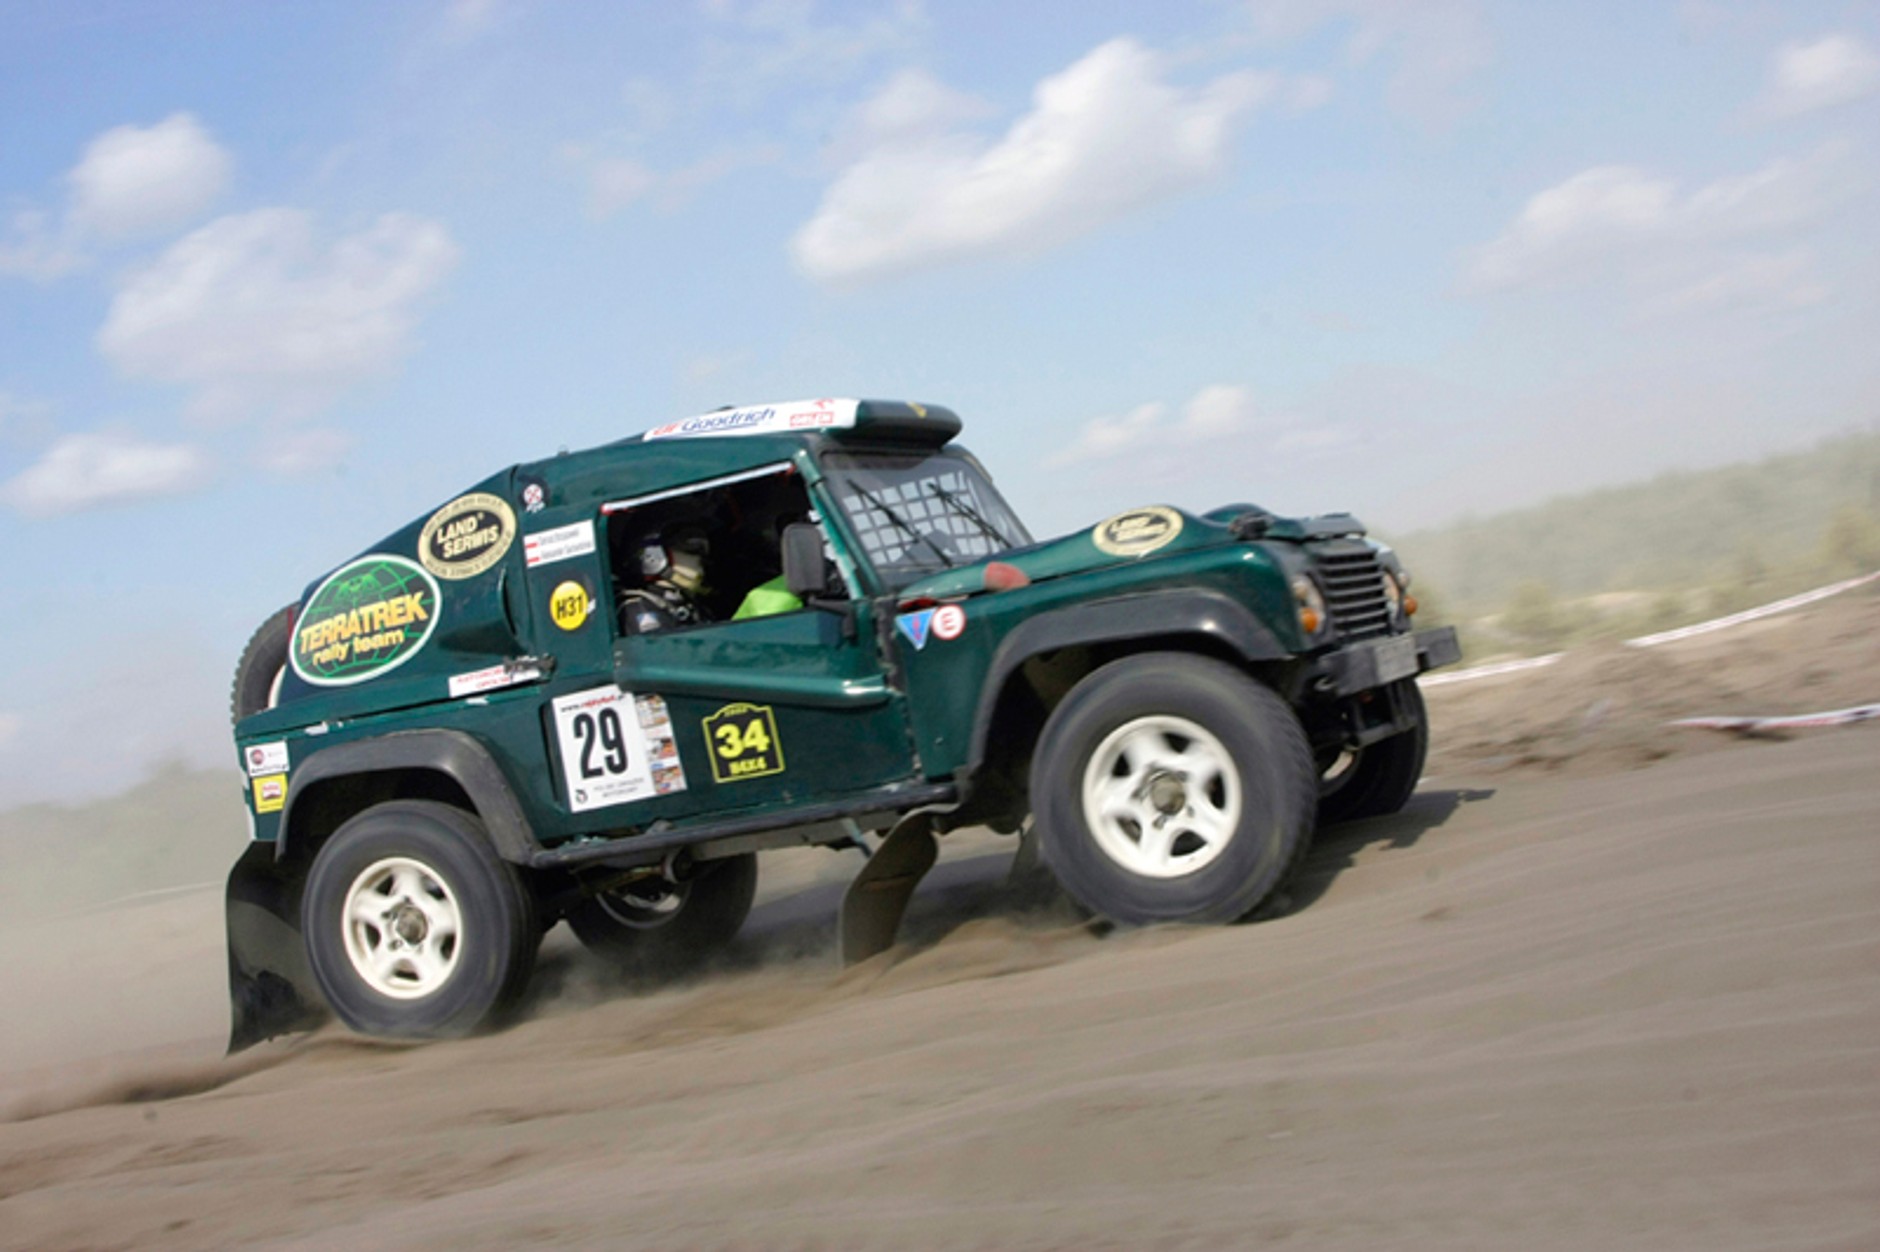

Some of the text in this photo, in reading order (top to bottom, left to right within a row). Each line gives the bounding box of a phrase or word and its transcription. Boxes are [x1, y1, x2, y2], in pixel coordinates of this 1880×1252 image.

[436, 516, 478, 545] LAND
[300, 590, 429, 654] TERRATREK
[556, 595, 584, 621] H31
[313, 629, 405, 667] rally team
[573, 706, 629, 780] 29
[715, 719, 770, 759] 34
